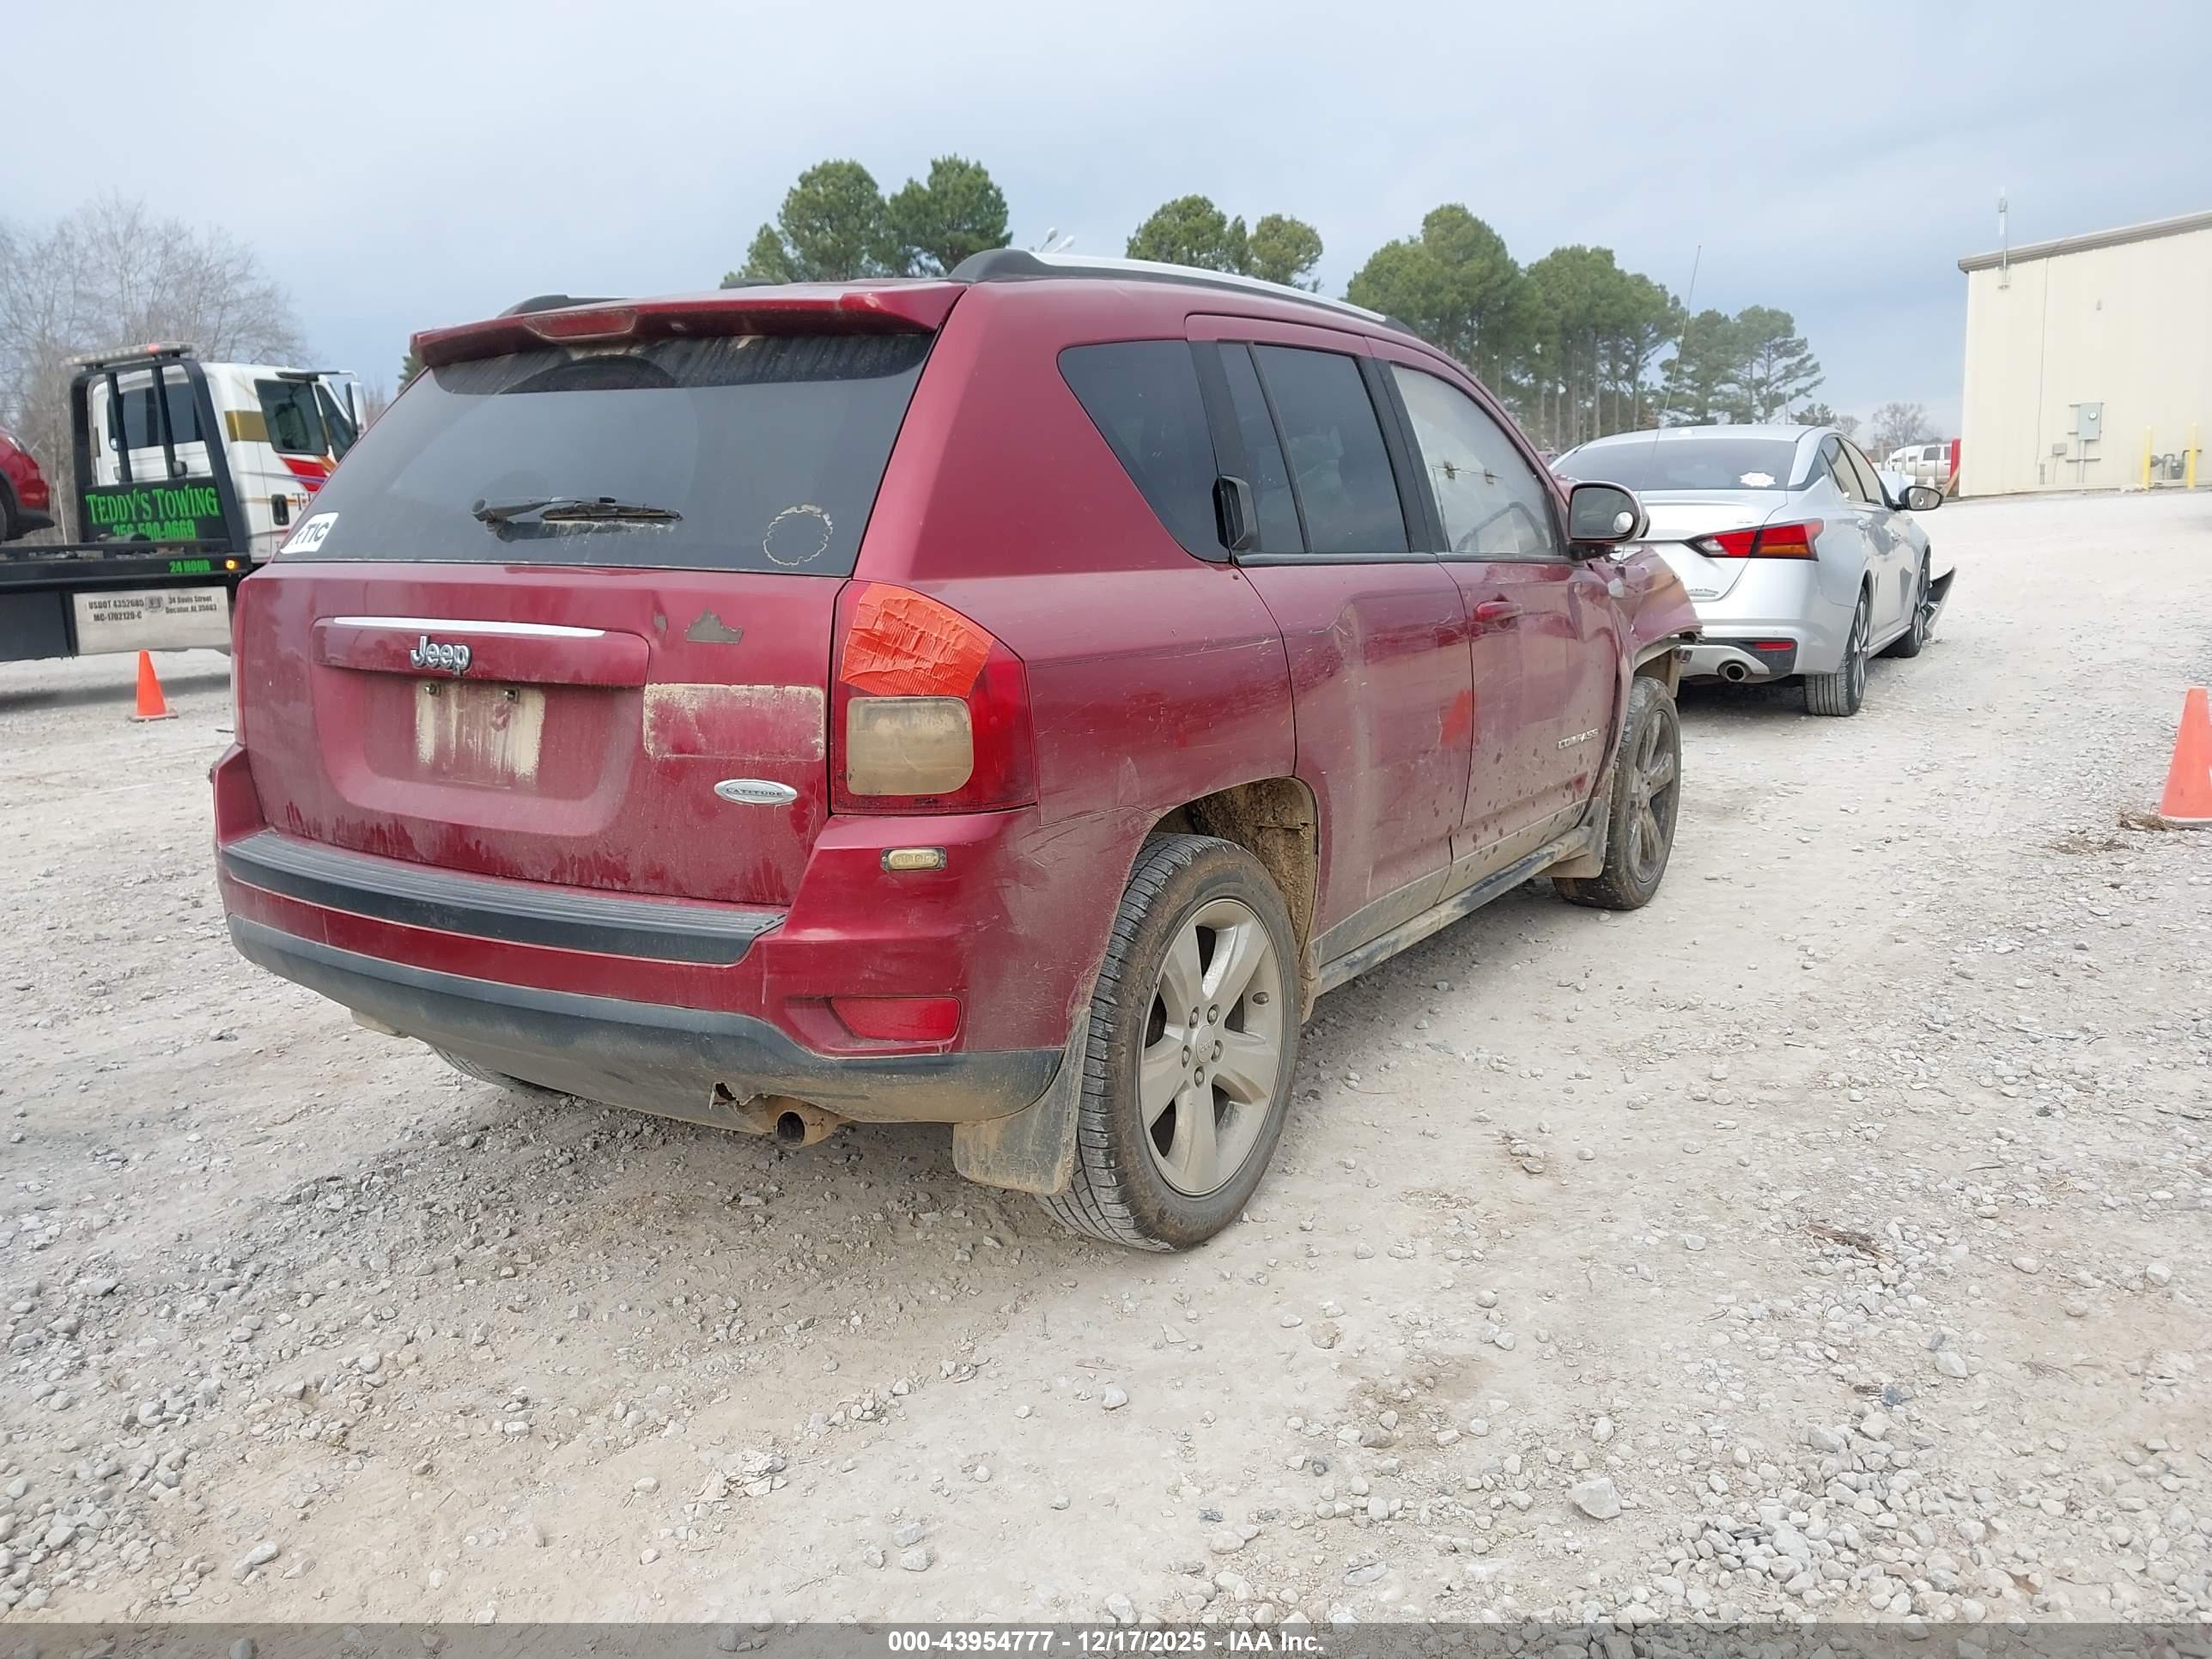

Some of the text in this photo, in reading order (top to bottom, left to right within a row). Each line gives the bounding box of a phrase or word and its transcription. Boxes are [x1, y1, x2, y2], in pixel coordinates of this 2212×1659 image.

[86, 483, 221, 524] TEDDY'S TOWING
[169, 560, 211, 573] 24 HOUR
[88, 599, 111, 610] USDOT
[410, 634, 471, 676] Jeep
[1558, 728, 1599, 750] COMPASS
[726, 787, 783, 798] LATITUDE
